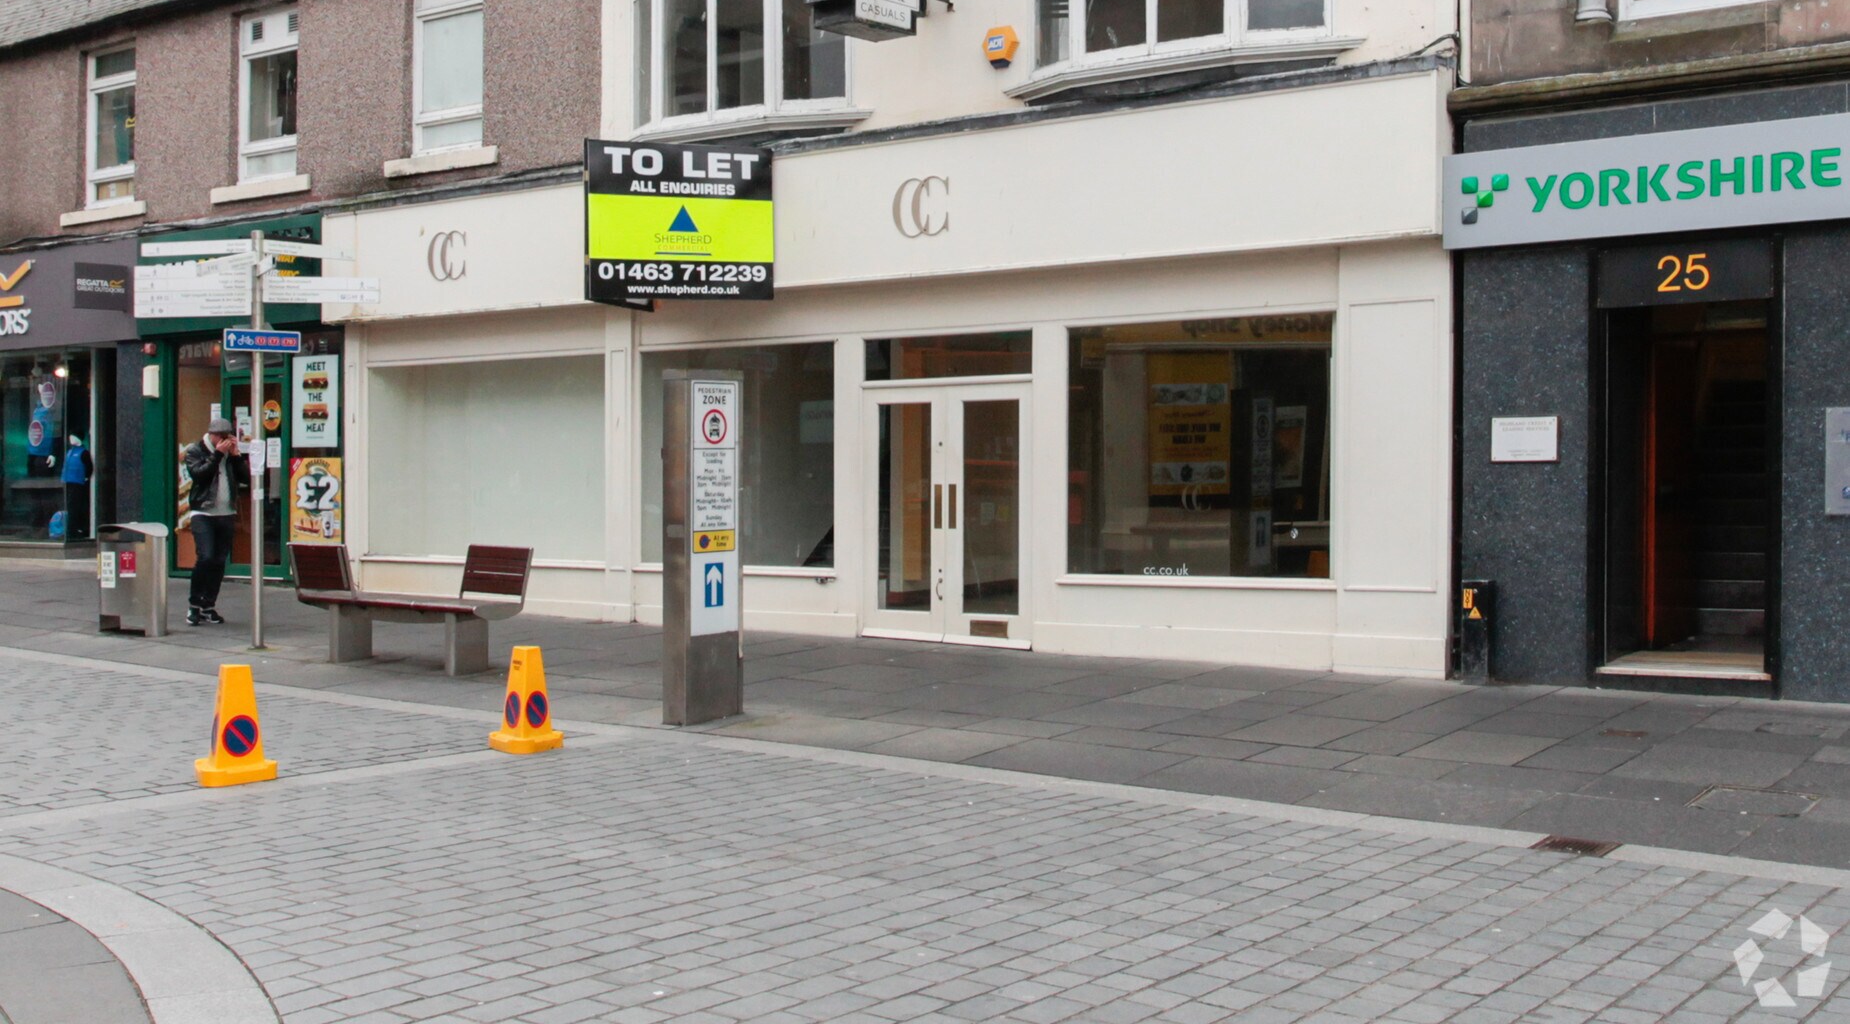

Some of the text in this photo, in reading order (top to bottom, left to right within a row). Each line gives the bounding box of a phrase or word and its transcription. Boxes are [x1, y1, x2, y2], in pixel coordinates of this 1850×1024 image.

[861, 2, 906, 22] CASUALS
[604, 147, 760, 181] TO LET
[630, 180, 736, 196] ALL ENQUIRIES
[1525, 147, 1842, 213] YORKSHIRE
[892, 176, 949, 239] CC
[654, 233, 712, 245] SHEPHERD
[427, 230, 467, 282] CC
[598, 262, 767, 282] 01463 712239
[1657, 253, 1711, 293] 25
[76, 278, 109, 287] REGATTA
[627, 284, 740, 296] www.shepherd.co.uk
[306, 361, 326, 371] MEET
[308, 392, 323, 401] THE
[703, 396, 726, 405] ZONE
[306, 423, 325, 432] MEAT
[296, 475, 340, 511] £2
[1143, 563, 1189, 576] cc.co.uk
